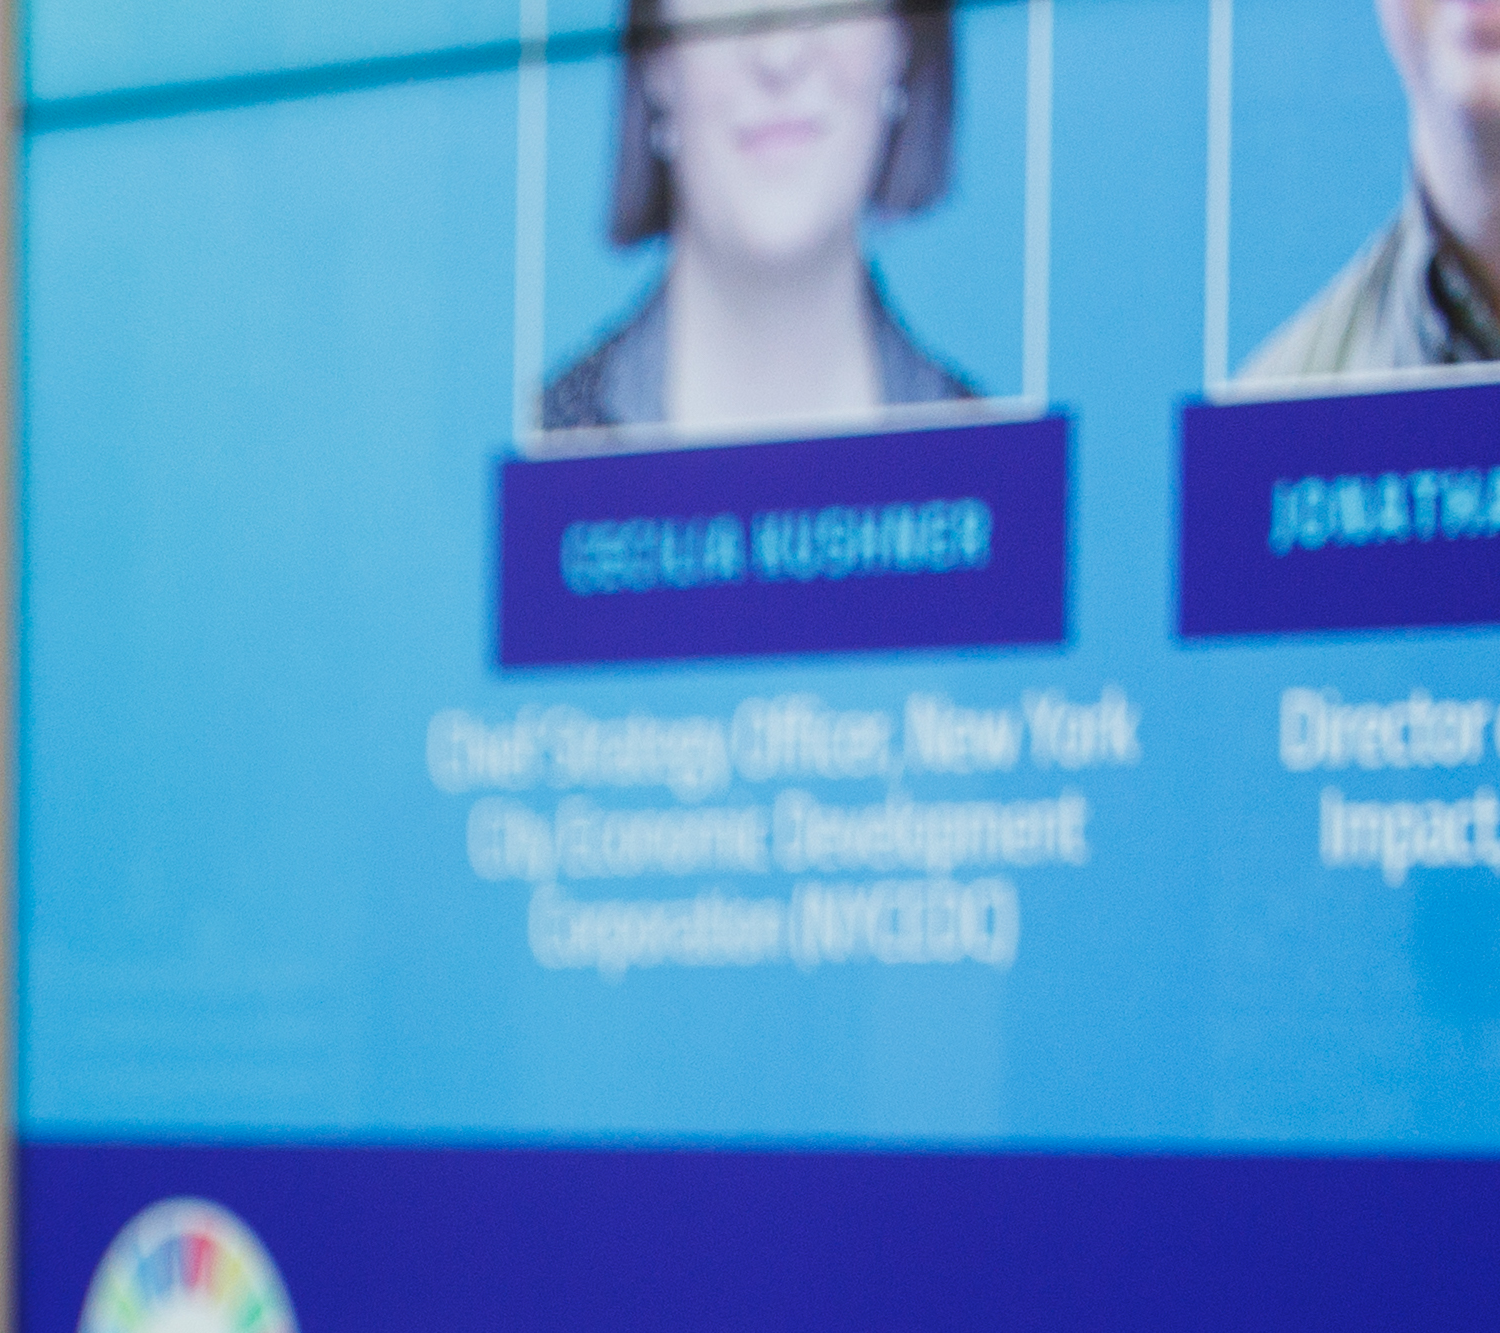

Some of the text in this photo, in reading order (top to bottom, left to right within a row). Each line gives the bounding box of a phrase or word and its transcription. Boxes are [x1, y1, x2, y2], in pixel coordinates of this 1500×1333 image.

[903, 691, 1021, 774] New
[1021, 684, 1142, 771] York
[1281, 688, 1486, 772] Director
[556, 795, 768, 880] Economic
[773, 788, 1092, 880] Development
[529, 882, 783, 984] Corporation
